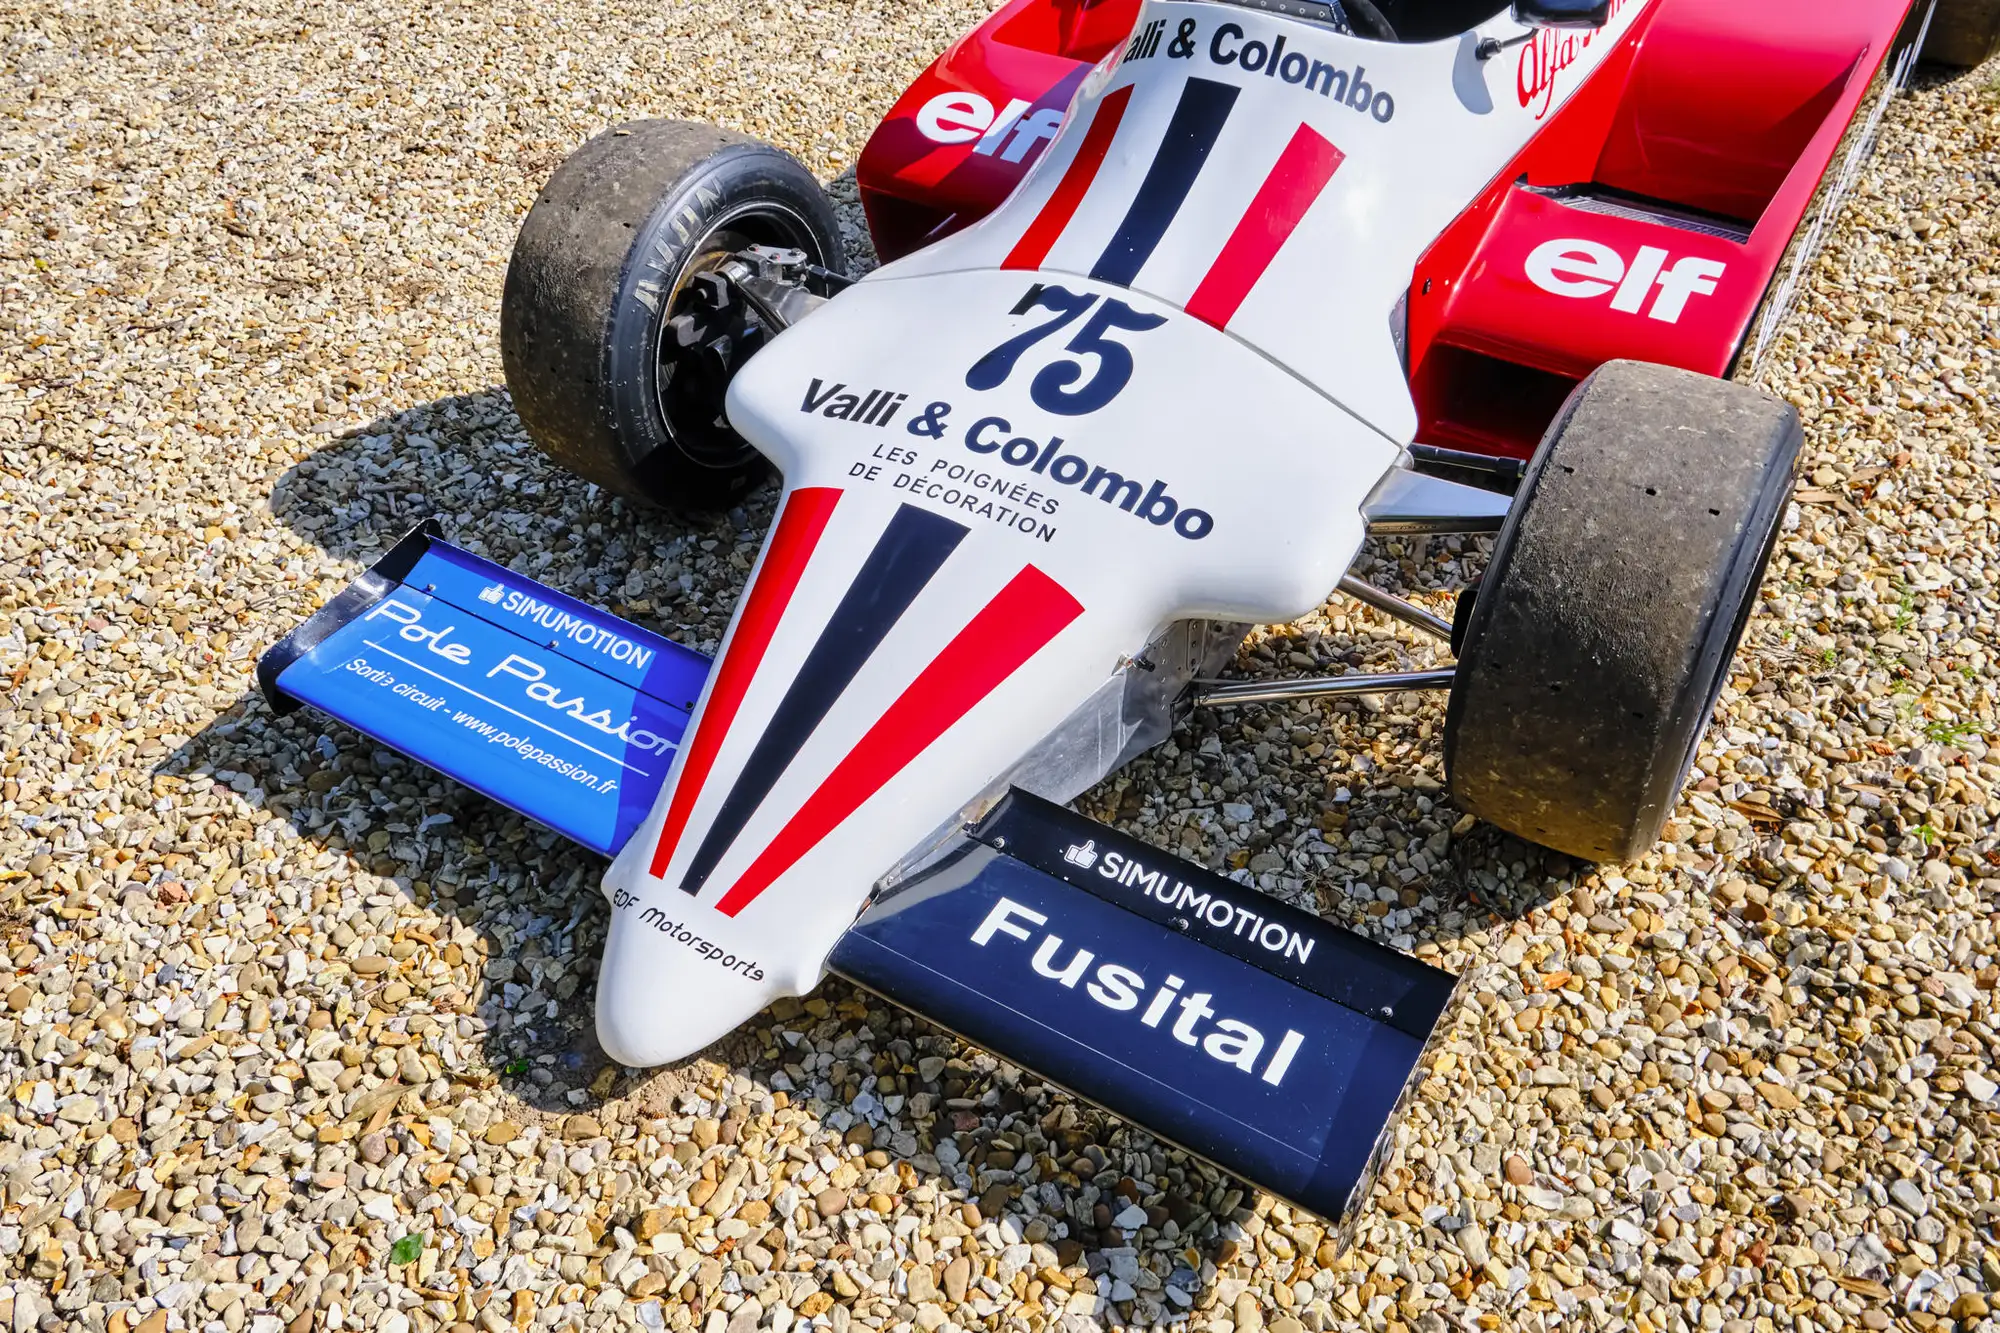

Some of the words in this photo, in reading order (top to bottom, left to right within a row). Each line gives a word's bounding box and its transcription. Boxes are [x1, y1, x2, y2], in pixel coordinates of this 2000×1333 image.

[1122, 19, 1167, 64] alli
[1167, 17, 1196, 60] &
[1209, 22, 1396, 124] Colombo
[916, 91, 1066, 164] elf
[1524, 238, 1728, 324] elf
[965, 283, 1169, 416] 75
[800, 378, 908, 428] Valli
[906, 401, 953, 440] &
[964, 416, 1214, 540] Colombo
[848, 461, 882, 481] DE
[892, 475, 1058, 543] DÉCORATION
[872, 443, 919, 466] LES
[930, 458, 1061, 516] POIGNÉES
[364, 599, 472, 666] Pole
[502, 590, 653, 670] SIMUMOTION
[392, 683, 447, 712] circuit
[451, 710, 618, 795] www.polepassion.fr
[613, 887, 641, 911] EDF
[1098, 852, 1316, 965] SIMUMOTION
[970, 896, 1305, 1087] Fusital
